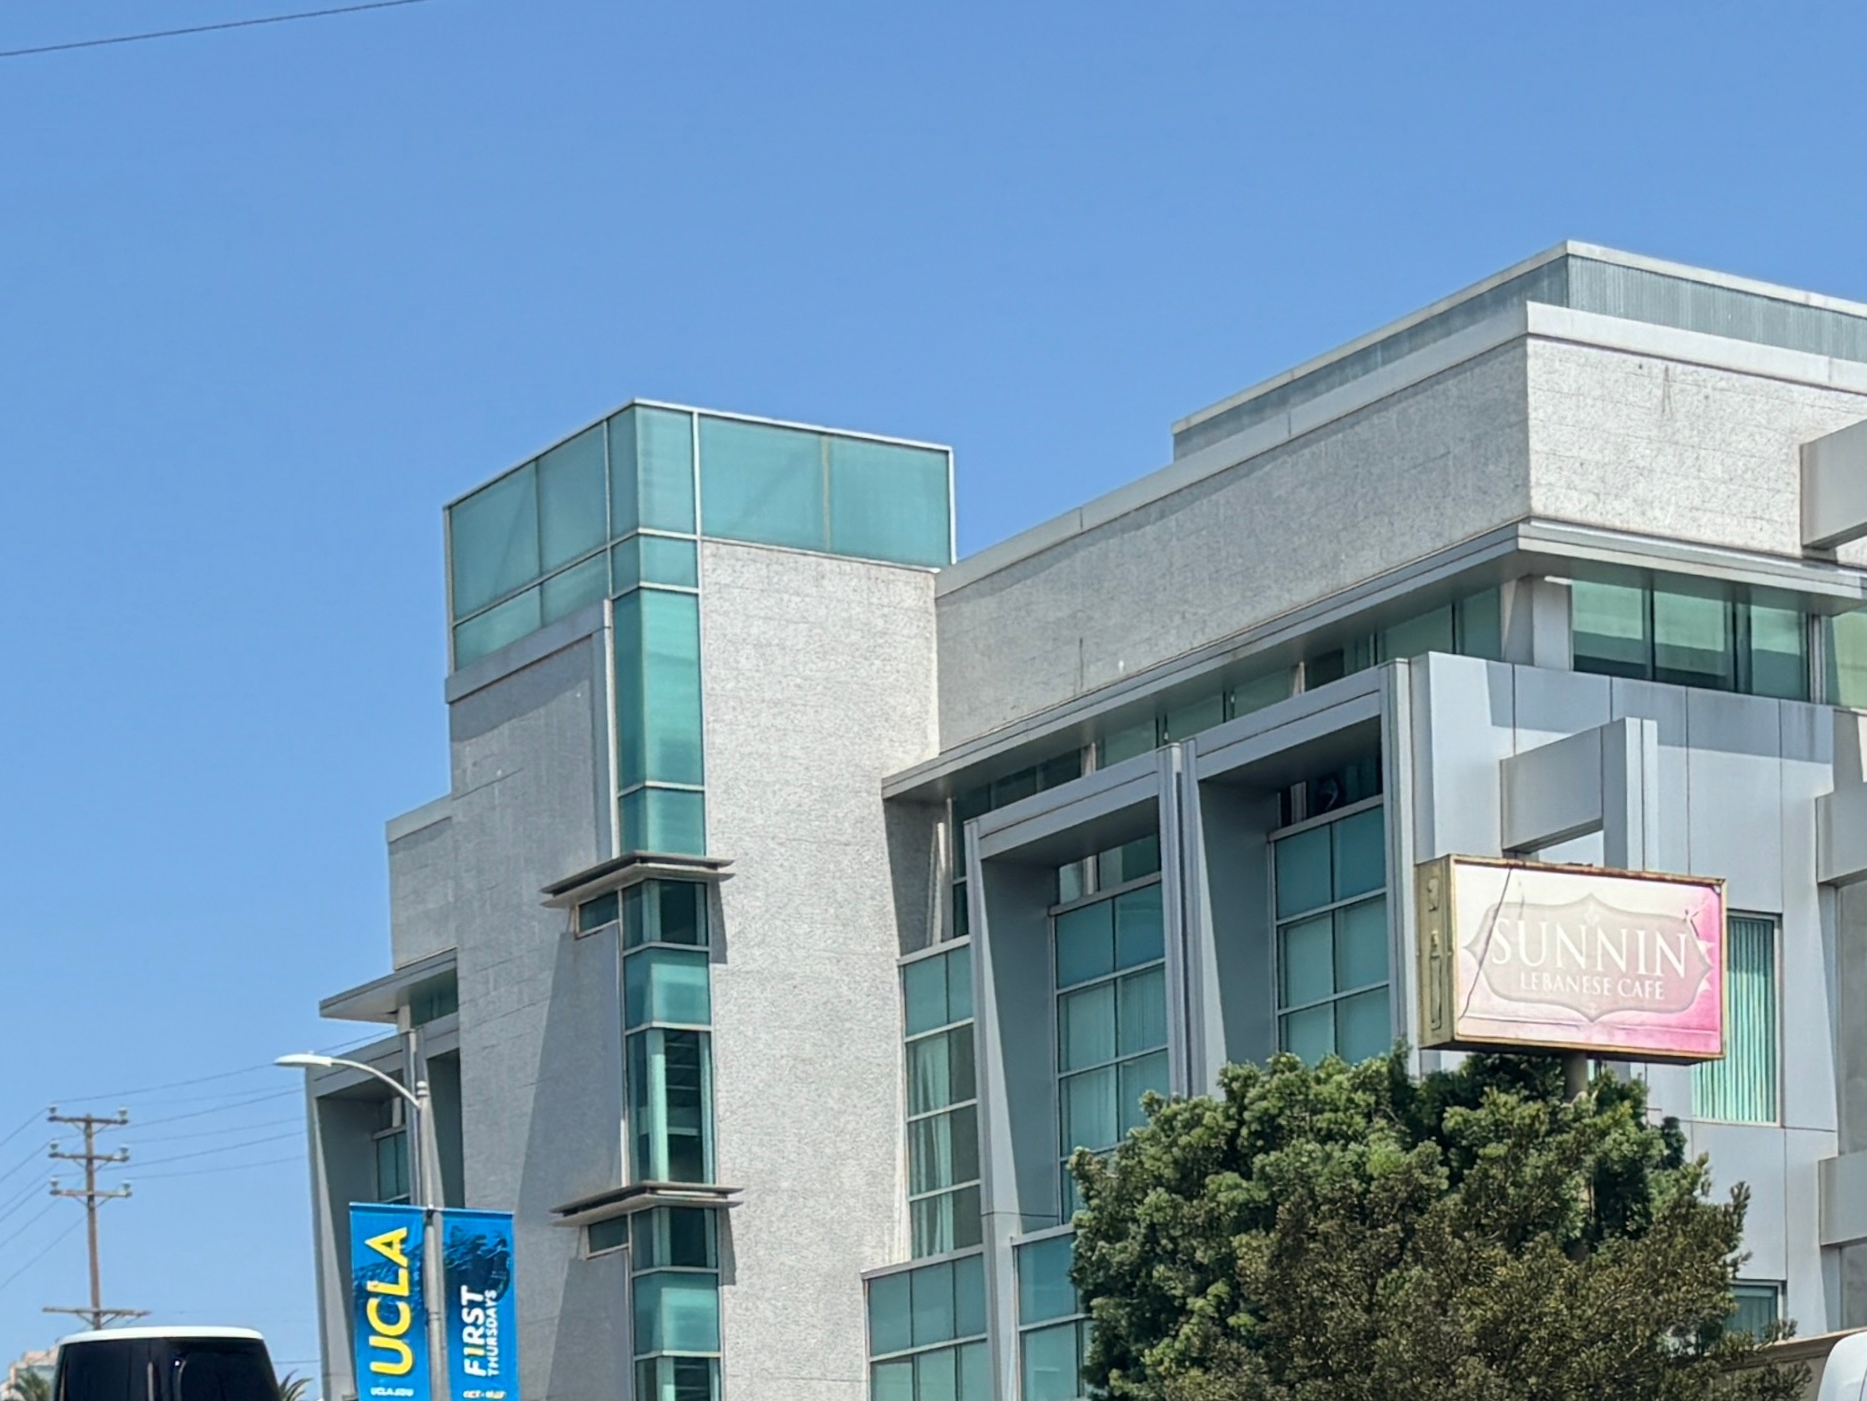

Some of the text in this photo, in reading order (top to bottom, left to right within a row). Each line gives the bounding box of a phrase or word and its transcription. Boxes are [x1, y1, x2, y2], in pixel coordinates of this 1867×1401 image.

[1490, 917, 1688, 979] SUNNIN
[1519, 972, 1665, 1000] LEBANESE CAFE
[364, 1227, 415, 1376] UCLA
[482, 1288, 500, 1378] THURSDAYS
